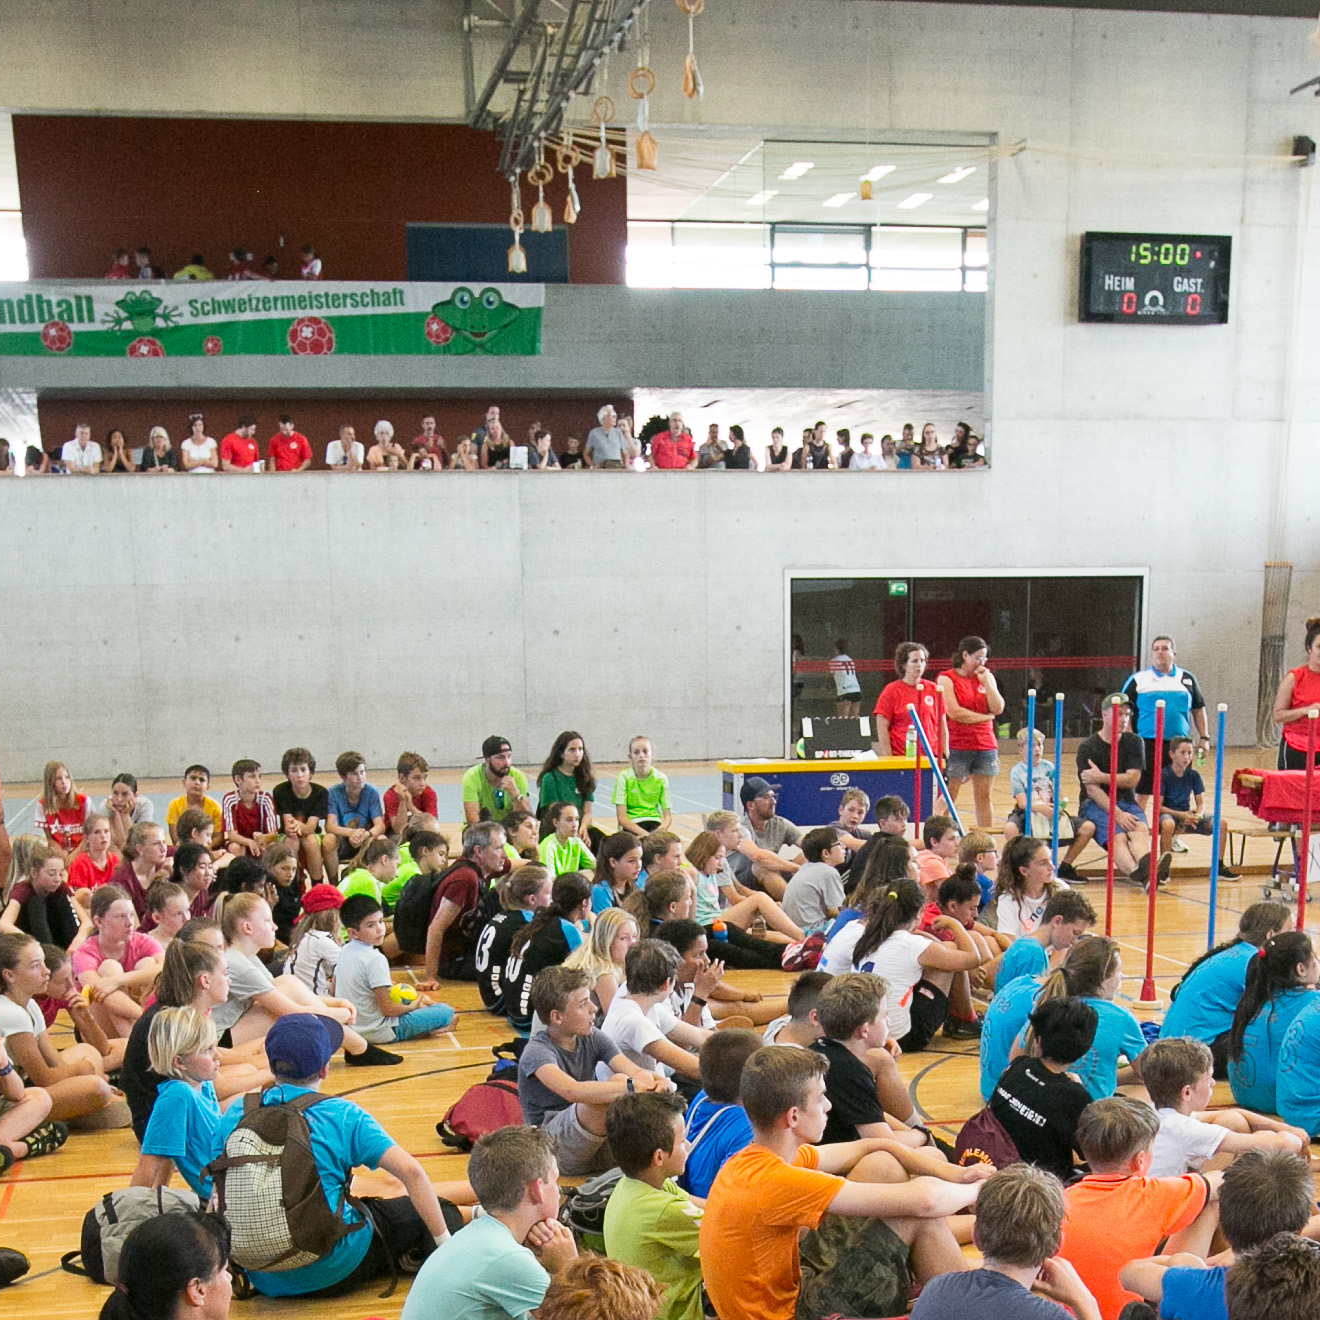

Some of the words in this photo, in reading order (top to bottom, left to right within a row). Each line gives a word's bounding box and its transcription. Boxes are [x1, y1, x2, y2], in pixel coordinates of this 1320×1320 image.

[1130, 243, 1190, 265] 15:00
[1105, 275, 1134, 291] HEIM
[188, 287, 405, 318] Schweizermeisterschaft
[1122, 293, 1137, 314] 0
[1186, 294, 1201, 315] 0
